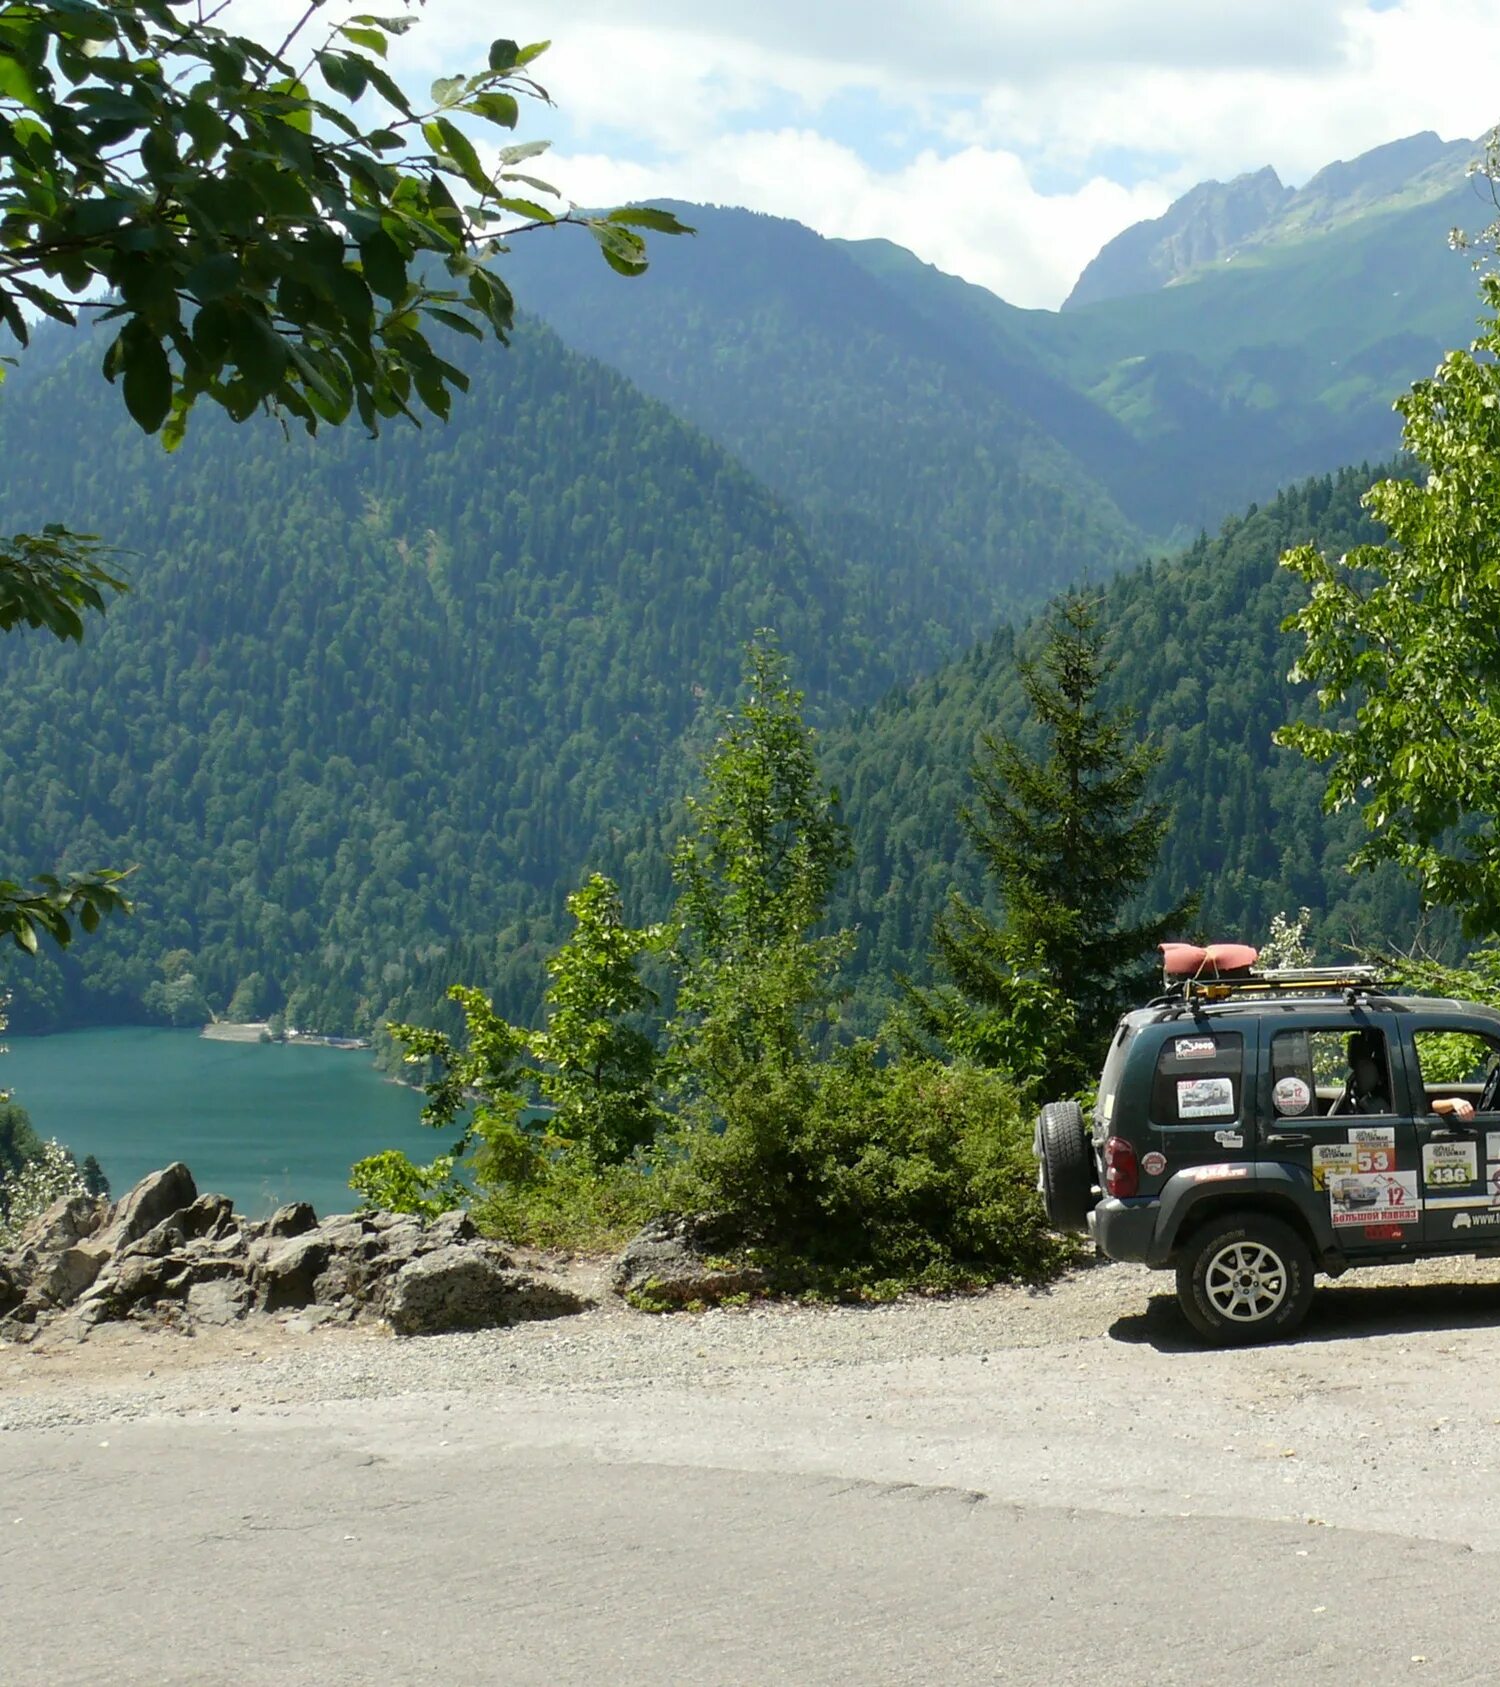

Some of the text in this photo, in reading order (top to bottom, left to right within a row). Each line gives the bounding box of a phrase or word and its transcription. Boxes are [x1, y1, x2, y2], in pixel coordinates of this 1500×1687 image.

[1358, 1151, 1389, 1171] 53
[1433, 1167, 1467, 1183] 136
[1387, 1187, 1405, 1206] 12
